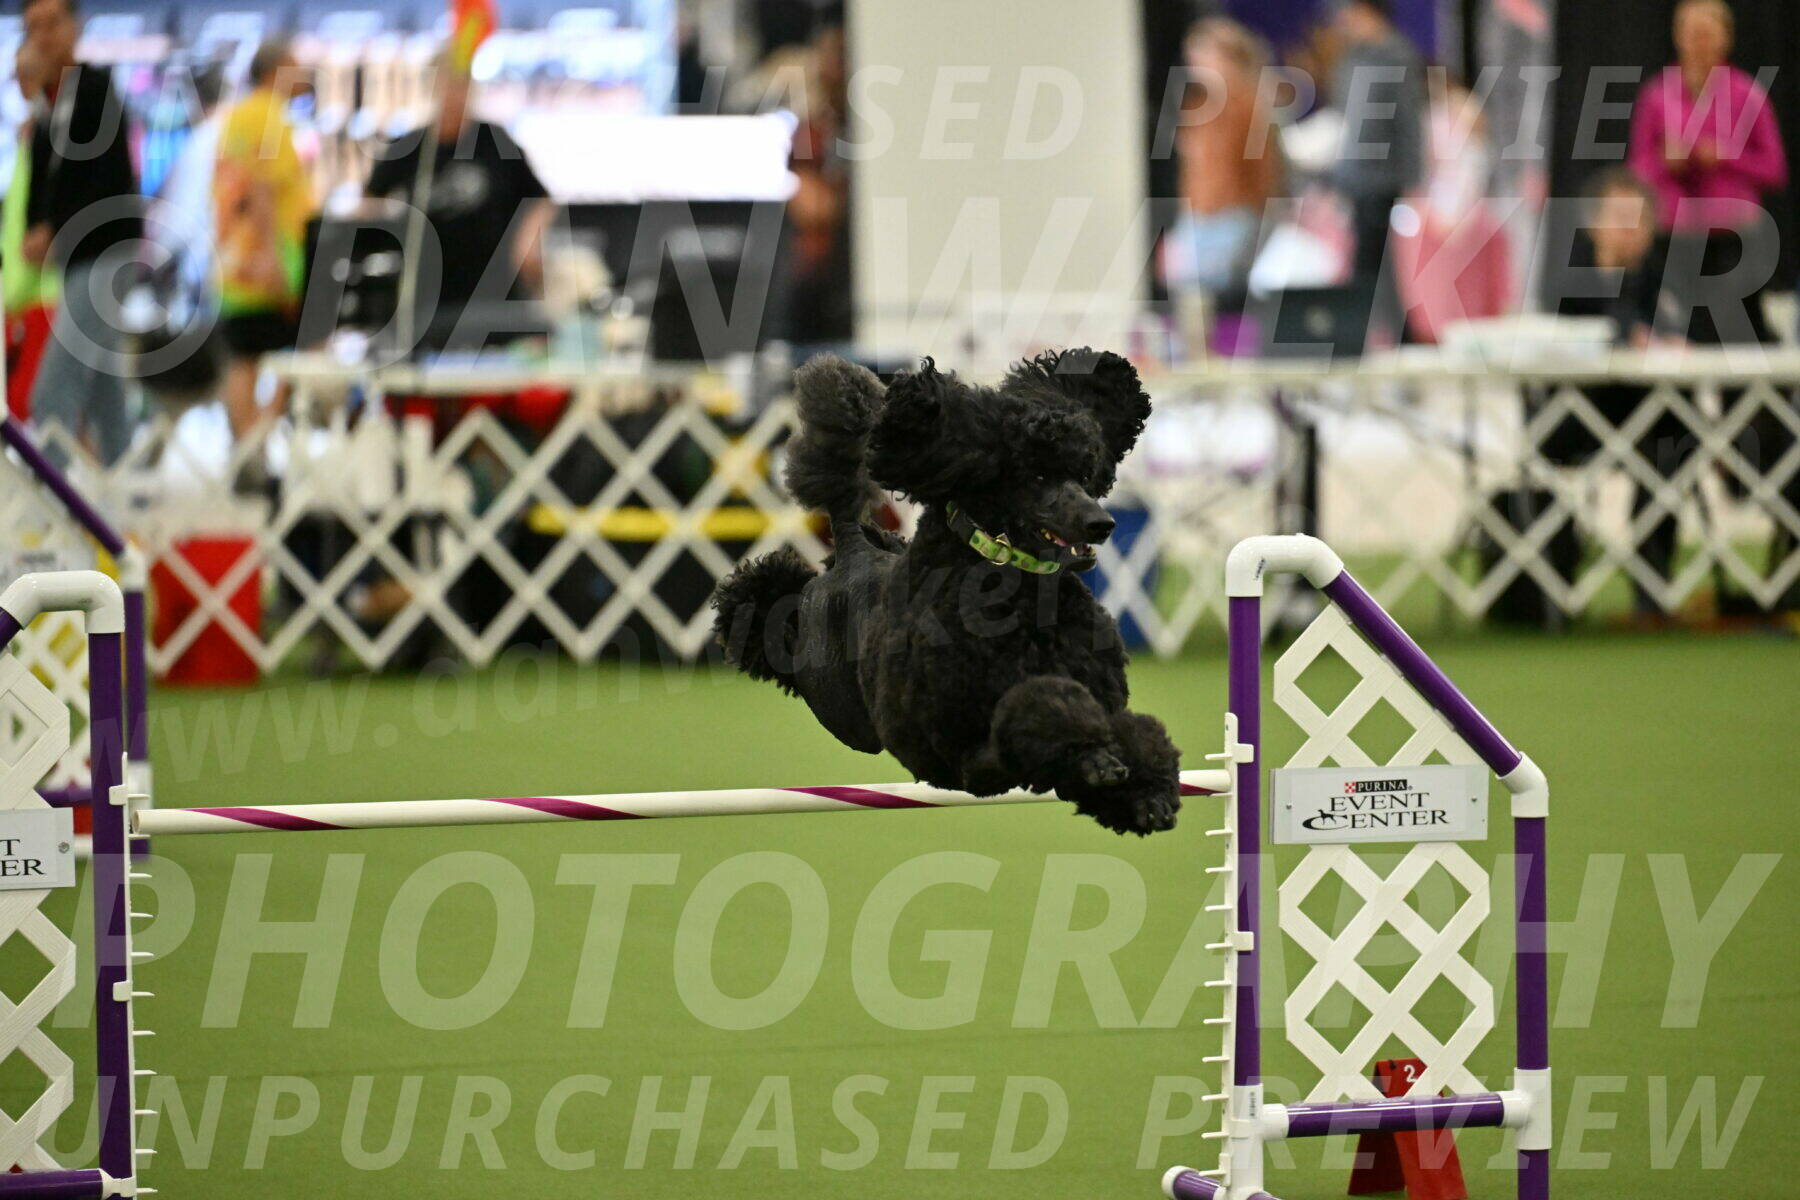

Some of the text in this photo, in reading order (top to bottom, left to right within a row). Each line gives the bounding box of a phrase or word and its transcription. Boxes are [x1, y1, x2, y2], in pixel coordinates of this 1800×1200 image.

[1357, 780, 1406, 791] PURINA
[1329, 792, 1430, 811] EVENT
[1302, 810, 1450, 831] CENTER
[1403, 1064, 1419, 1083] 2
